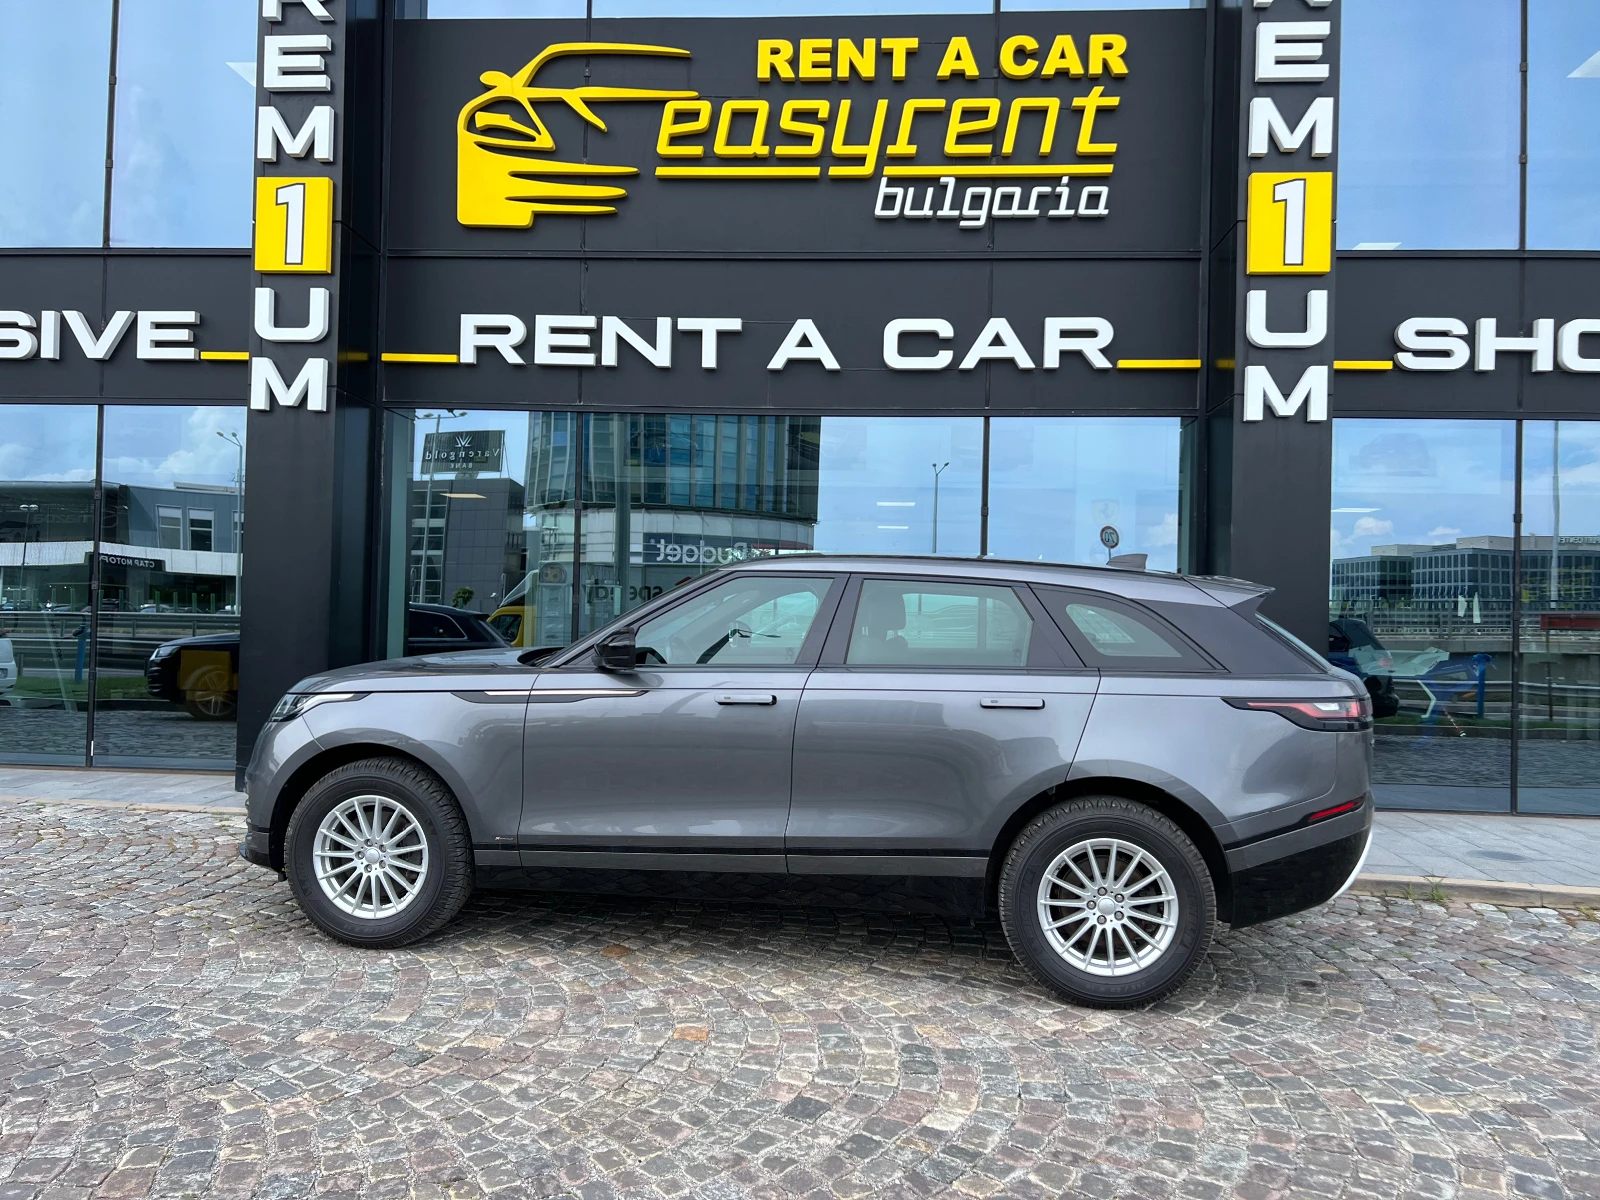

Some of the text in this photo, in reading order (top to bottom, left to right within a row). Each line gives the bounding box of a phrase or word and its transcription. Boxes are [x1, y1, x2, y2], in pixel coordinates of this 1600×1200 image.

[756, 34, 1129, 82] RENT A CAR
[655, 86, 1121, 179] easyrent
[874, 176, 1110, 229] bulgaria
[1243, 0, 1335, 422] EM1UM
[459, 313, 1115, 371] RENT A CAR
